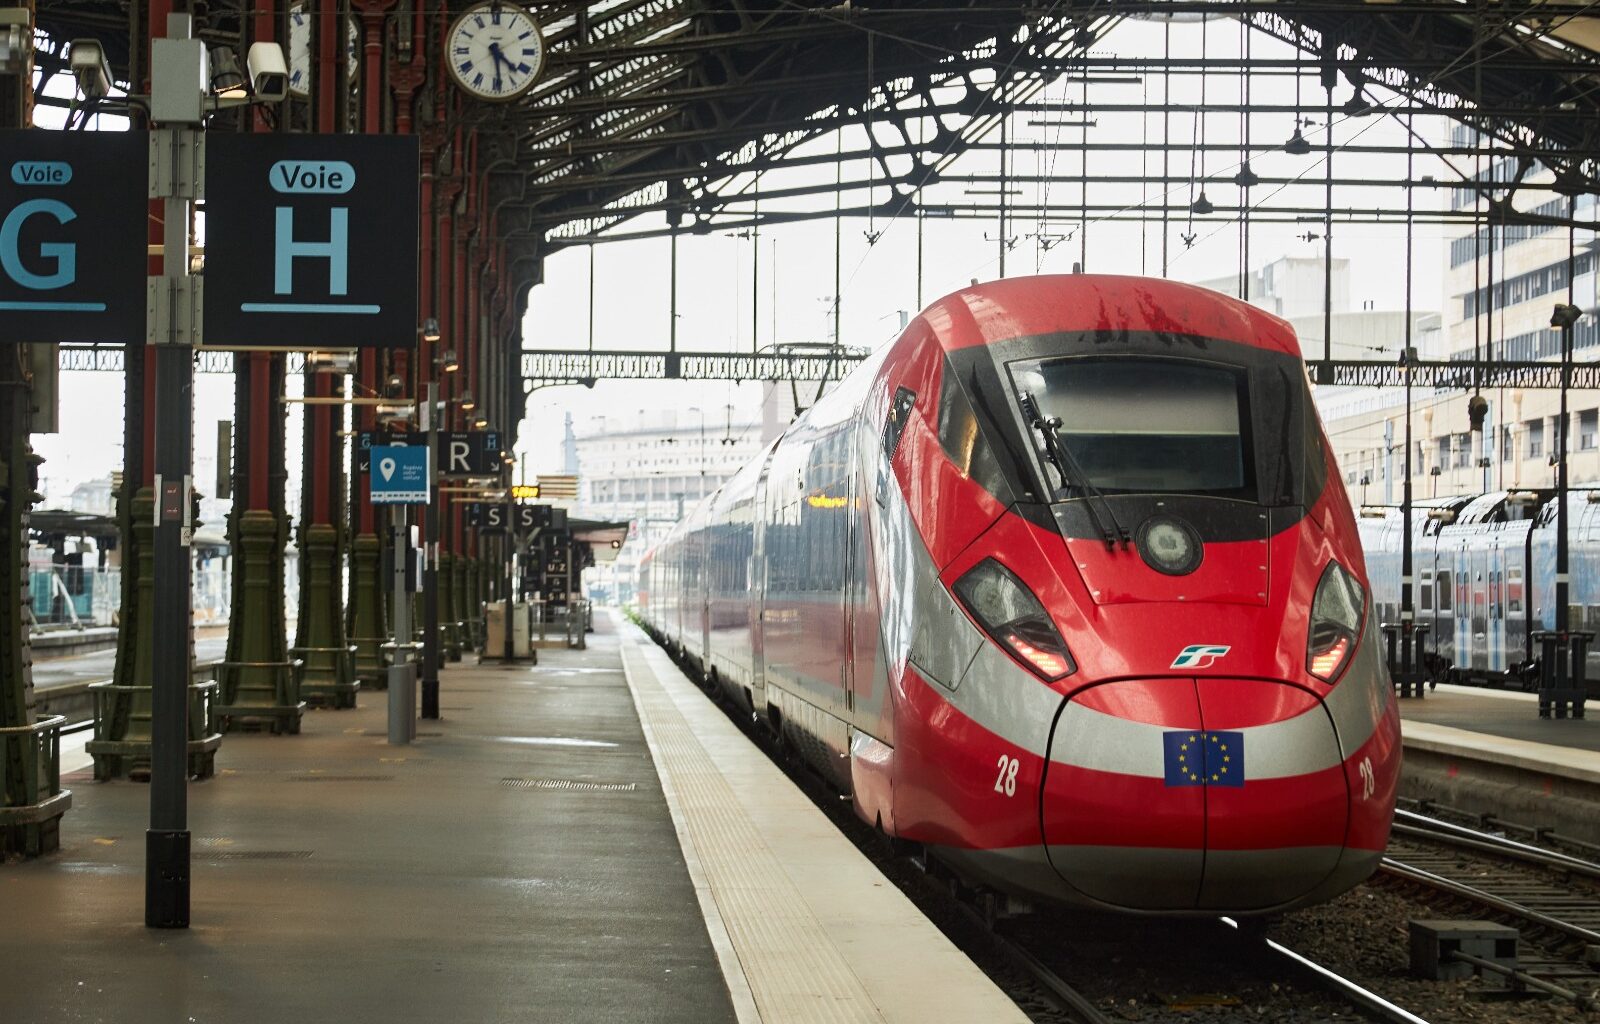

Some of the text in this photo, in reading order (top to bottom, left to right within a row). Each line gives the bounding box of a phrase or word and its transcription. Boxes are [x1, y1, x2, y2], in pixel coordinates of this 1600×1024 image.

[20, 165, 64, 182] Voie
[279, 164, 344, 190] Voie
[0, 198, 79, 290] G
[274, 206, 349, 296] H
[450, 441, 471, 471] R
[487, 439, 496, 448] H
[489, 507, 501, 526] S
[521, 508, 534, 527] S
[993, 754, 1020, 798] 28
[1358, 757, 1376, 801] 28
